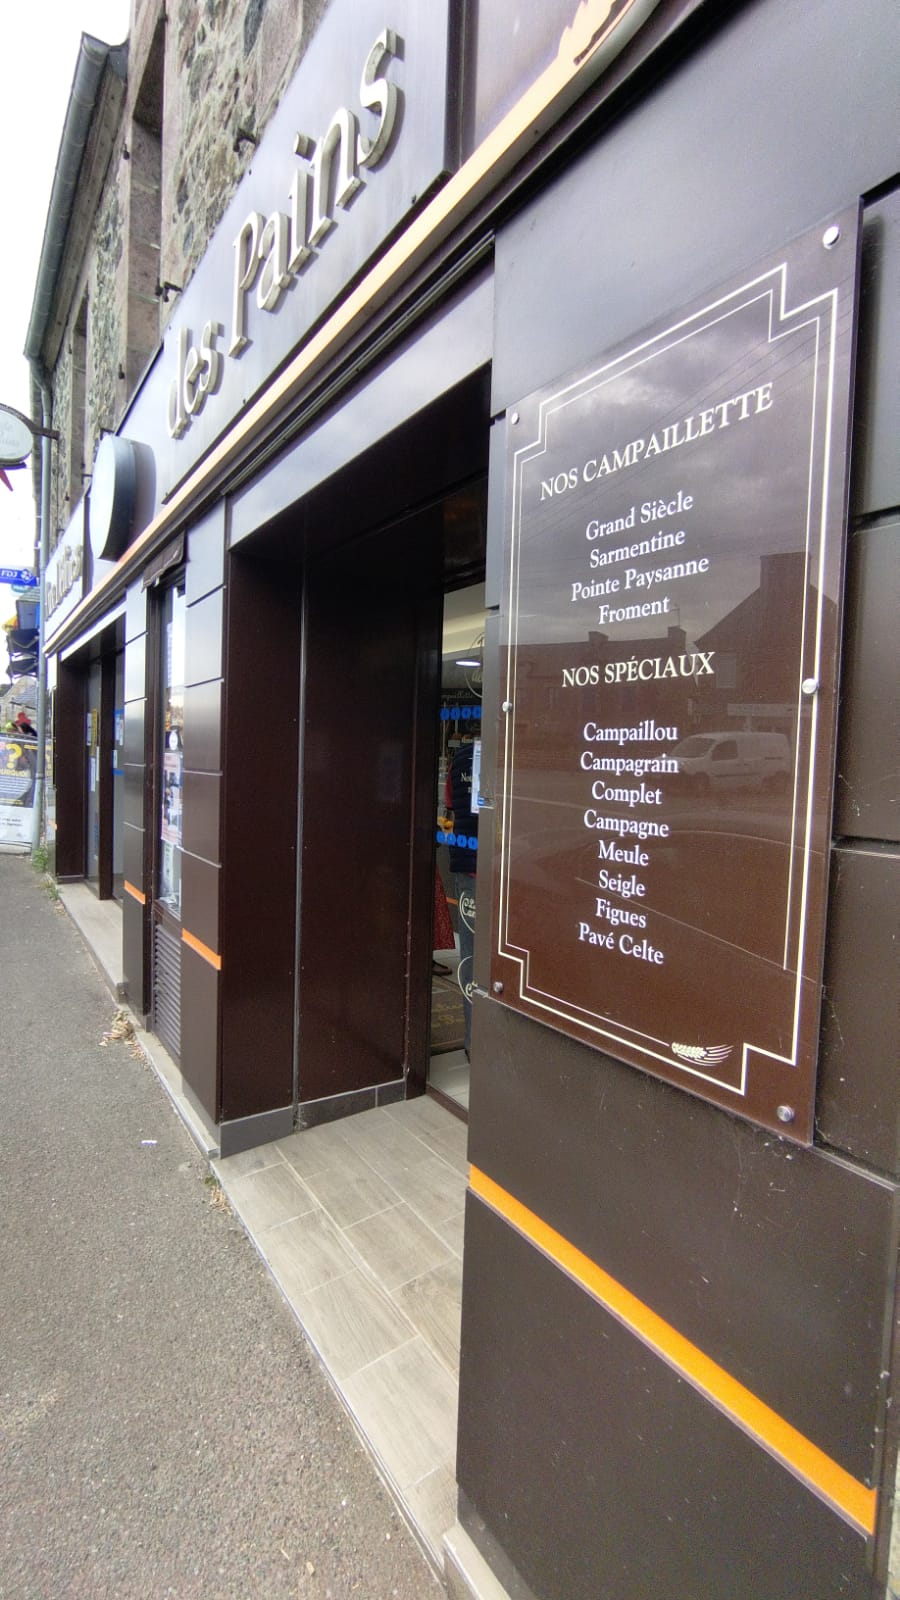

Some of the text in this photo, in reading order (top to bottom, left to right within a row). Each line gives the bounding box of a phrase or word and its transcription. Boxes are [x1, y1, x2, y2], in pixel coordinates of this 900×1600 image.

[168, 28, 404, 440] des Pains
[540, 382, 774, 501] NOS CAMPAILLETTE
[585, 490, 694, 541] Grand Siècle
[590, 530, 686, 569] Sarmentine
[571, 557, 710, 602] Pointe Paysanne
[598, 596, 671, 625] Froment
[561, 651, 716, 688] NOS SPÉCIAUX
[583, 720, 679, 746] Campaillou
[580, 751, 680, 777] Campagrain
[592, 780, 663, 808] Complet
[583, 809, 670, 840] Campagne
[598, 839, 650, 867] Meule
[598, 869, 646, 899] Seigle
[595, 897, 647, 929] Figues
[578, 921, 665, 965] Pavé Celte
